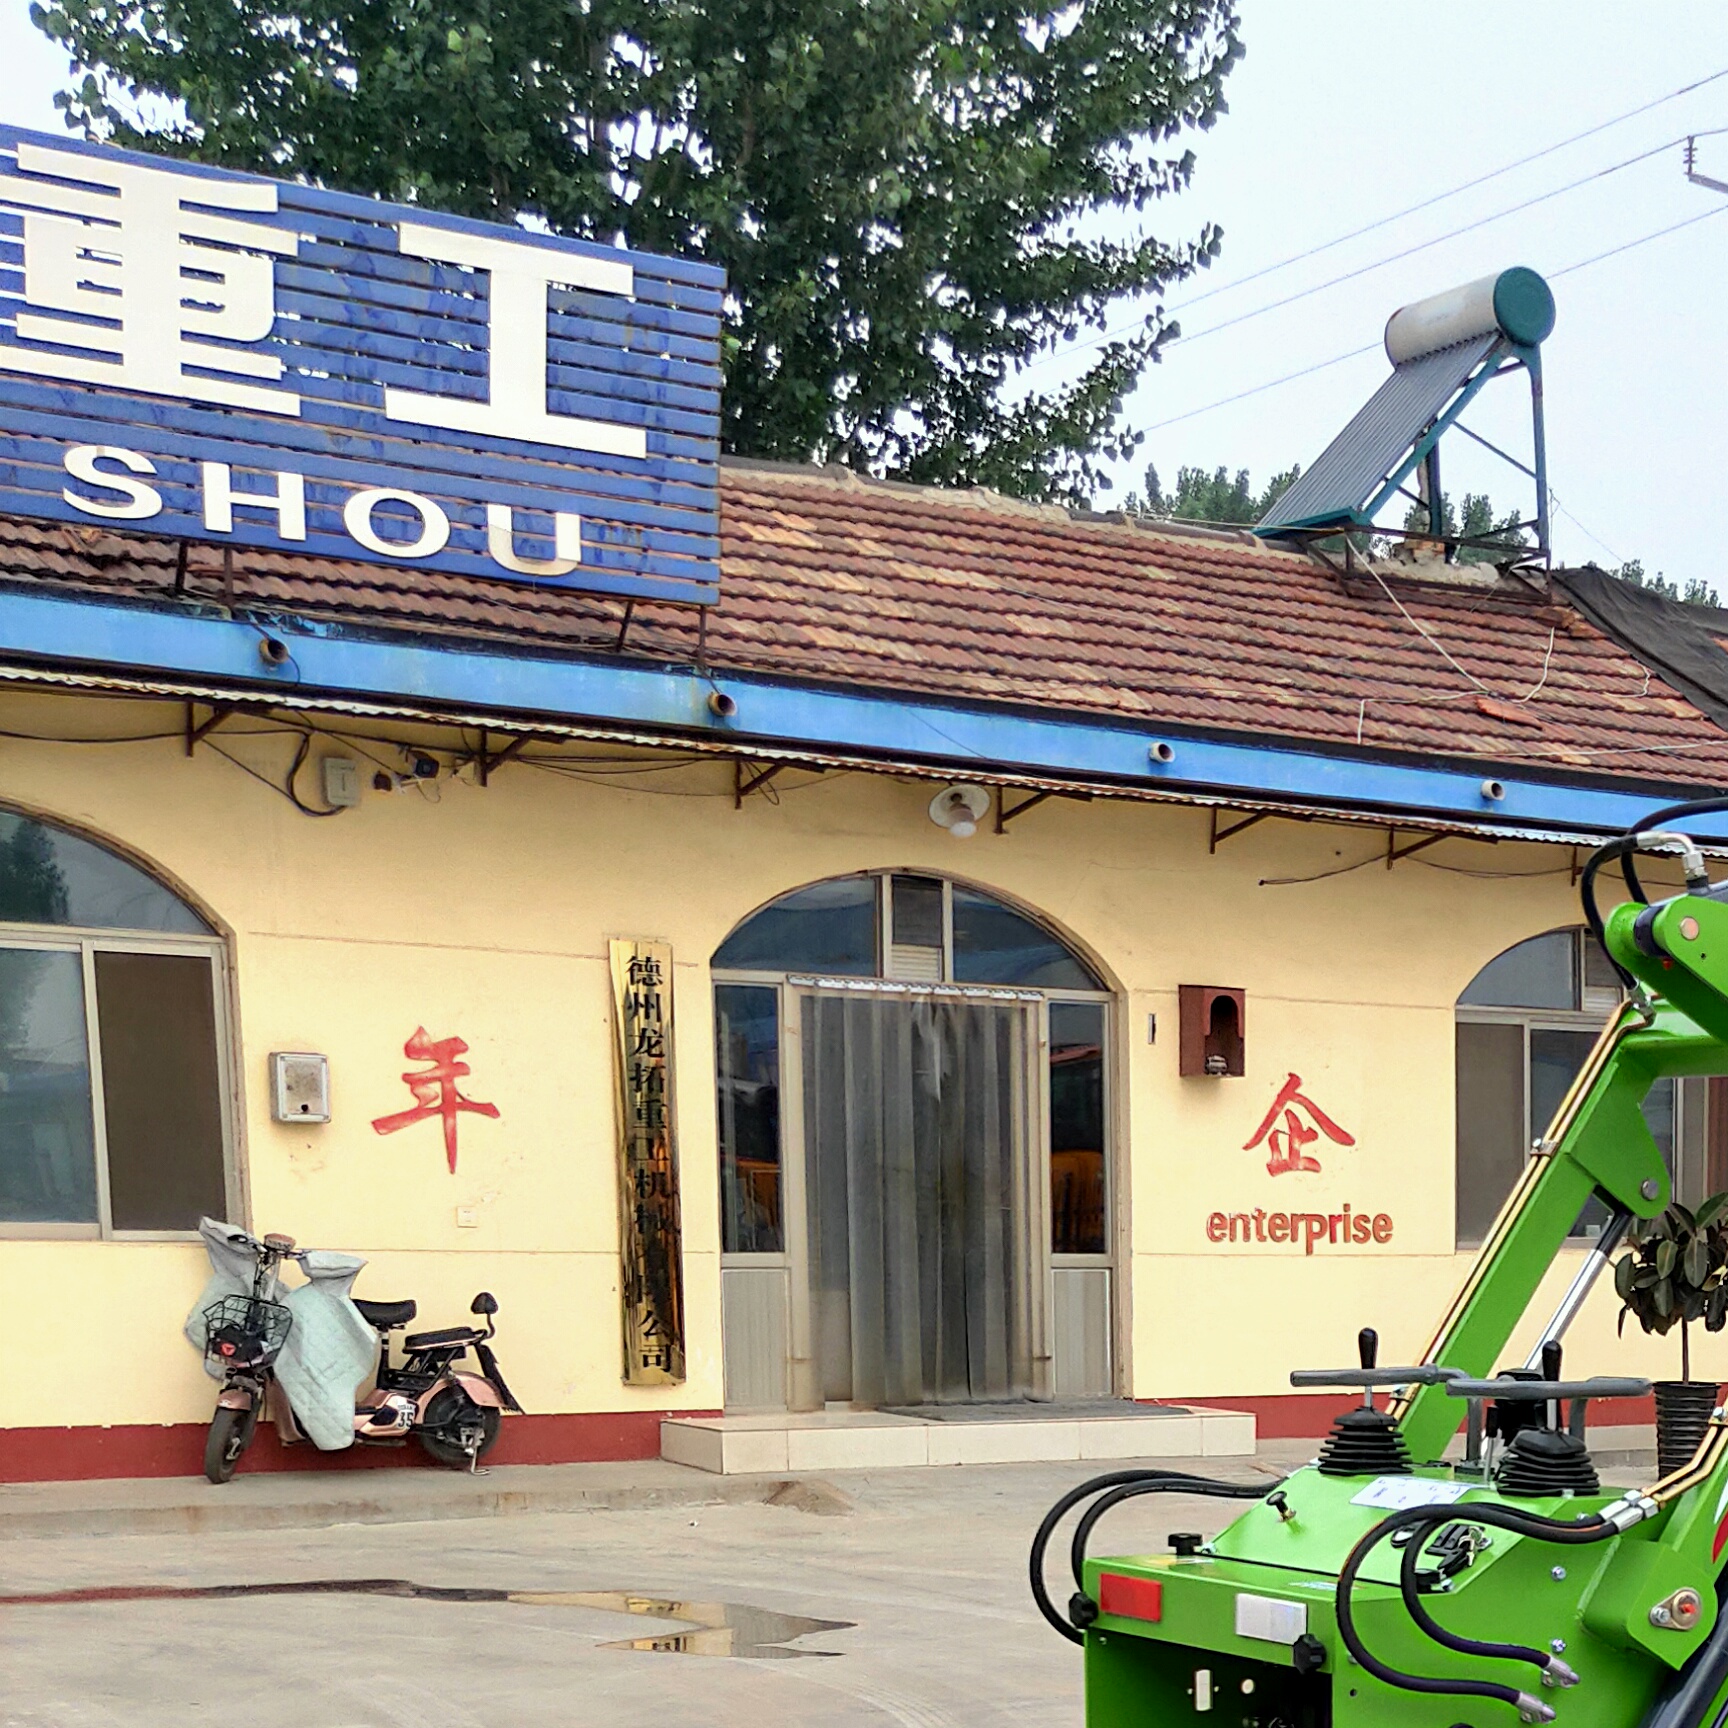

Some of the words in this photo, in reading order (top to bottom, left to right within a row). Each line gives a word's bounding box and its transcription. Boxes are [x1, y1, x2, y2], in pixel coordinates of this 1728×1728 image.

[0, 143, 647, 459] 重工
[62, 445, 581, 577] SHOU
[371, 1025, 500, 1175] 年
[625, 955, 676, 1373] 德州龙拓重工机械公司
[1242, 1072, 1356, 1177] 企
[1206, 1202, 1394, 1257] enterprise
